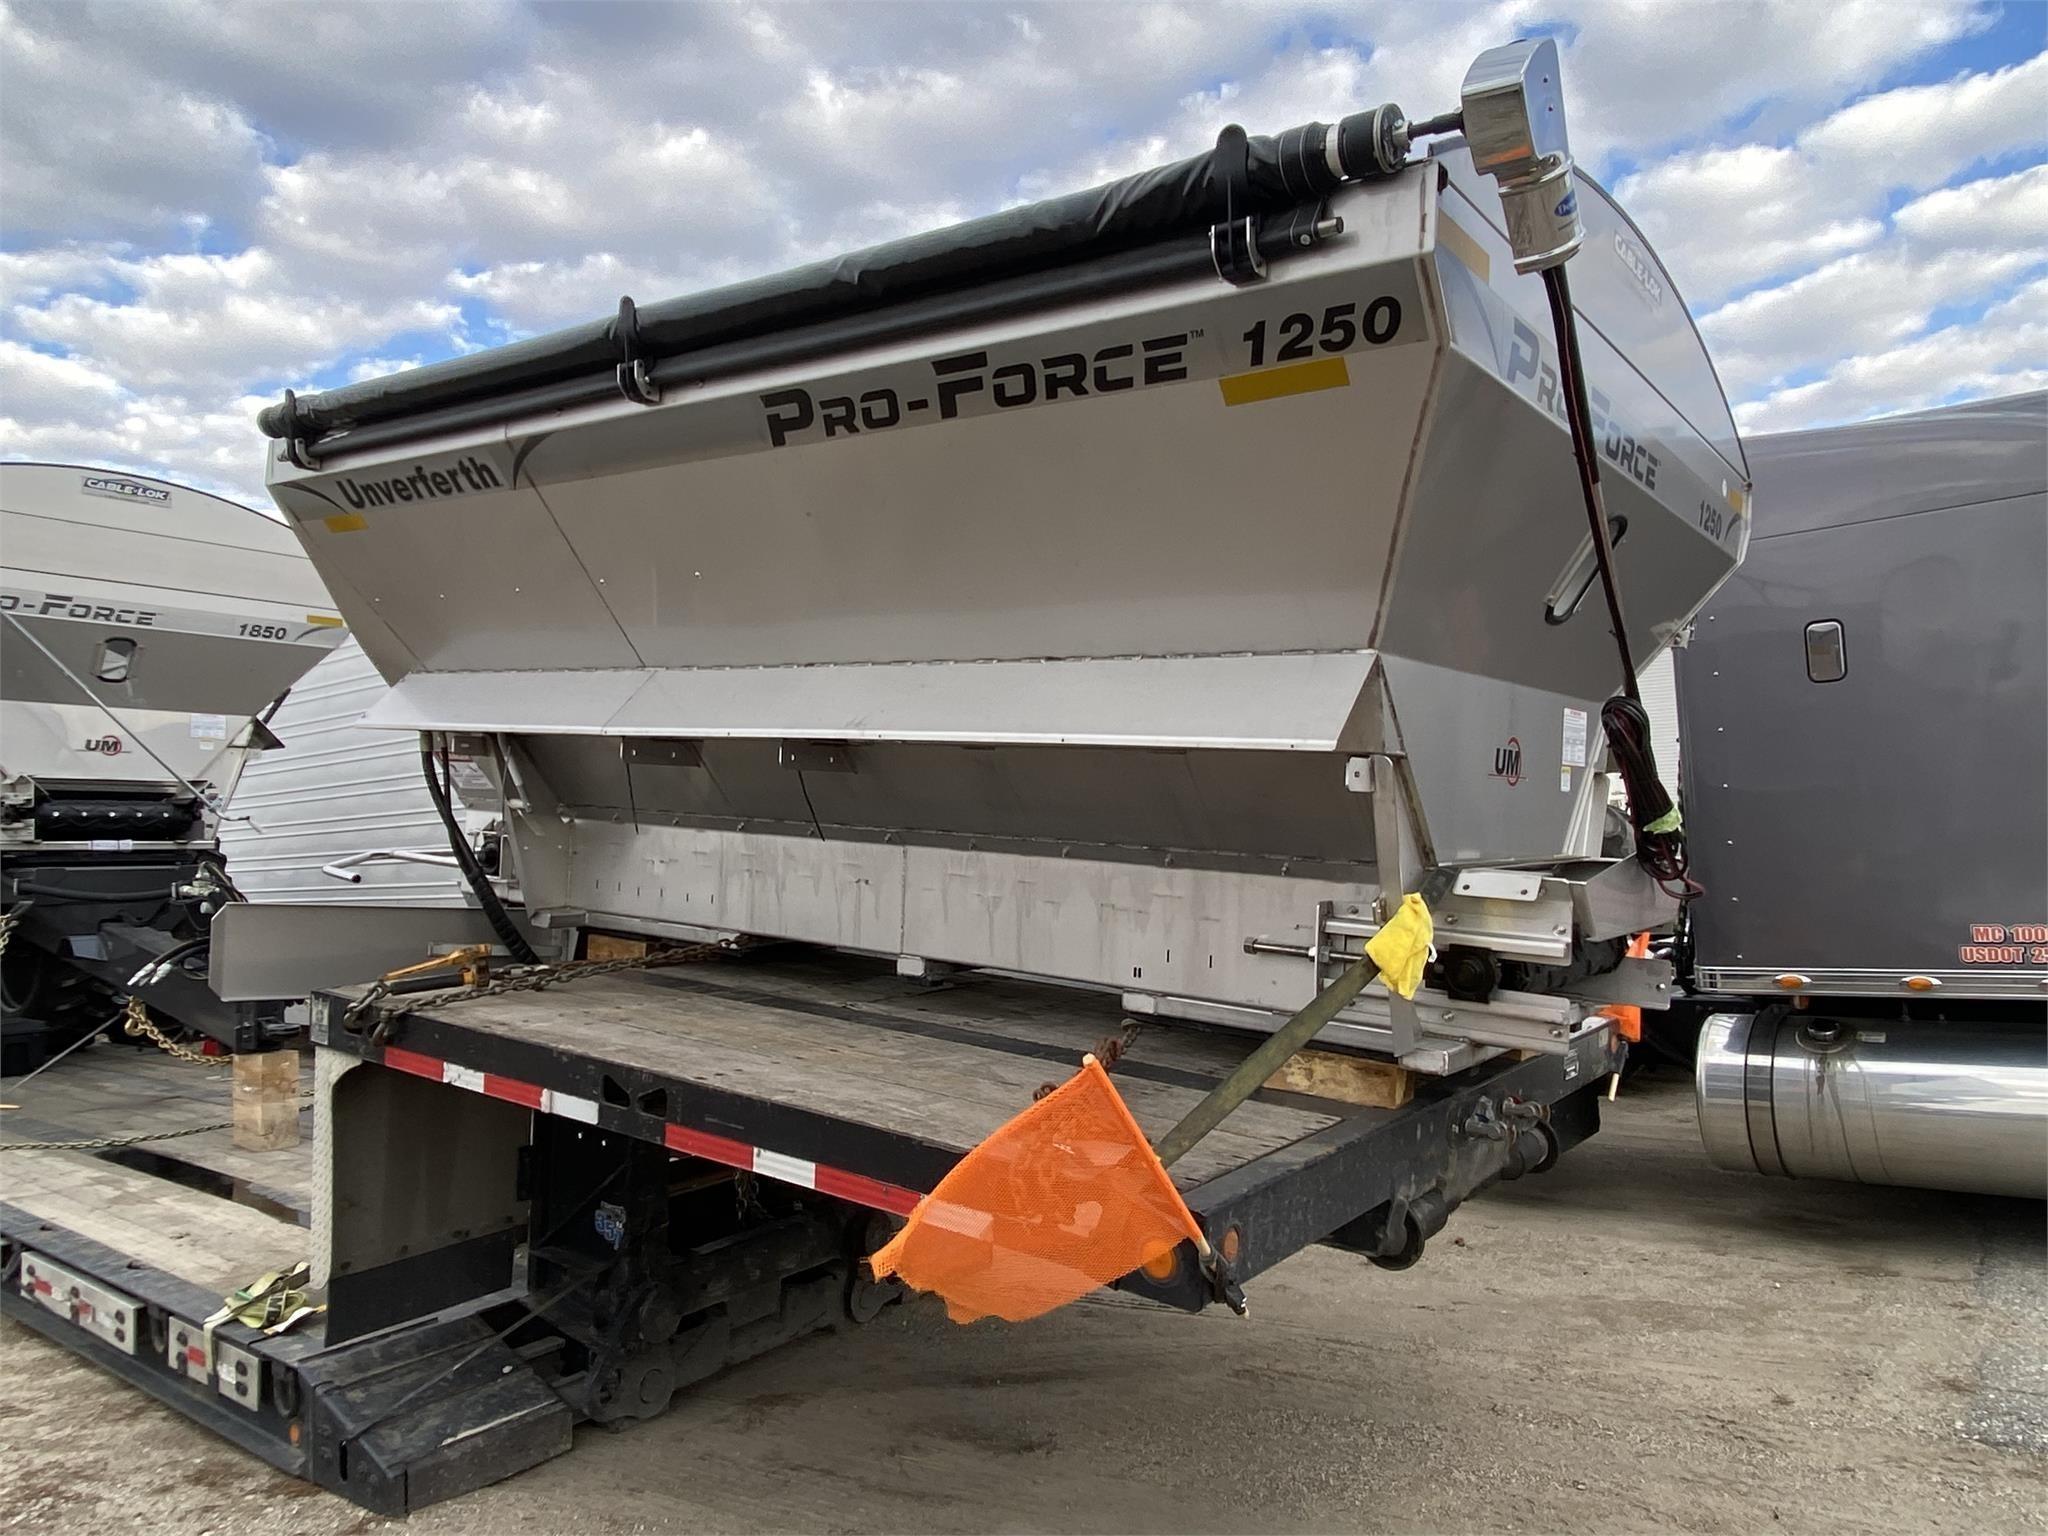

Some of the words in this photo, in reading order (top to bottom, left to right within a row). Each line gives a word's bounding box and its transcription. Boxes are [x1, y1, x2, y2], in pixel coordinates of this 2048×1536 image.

[1242, 295, 1402, 367] 1250
[336, 456, 503, 509] Unverferth
[1699, 499, 1722, 541] 1250
[239, 623, 288, 640] 1850
[84, 738, 119, 752] UM
[1494, 747, 1521, 775] UM
[1973, 926, 2004, 942] MC
[1961, 947, 2025, 963] USDOT
